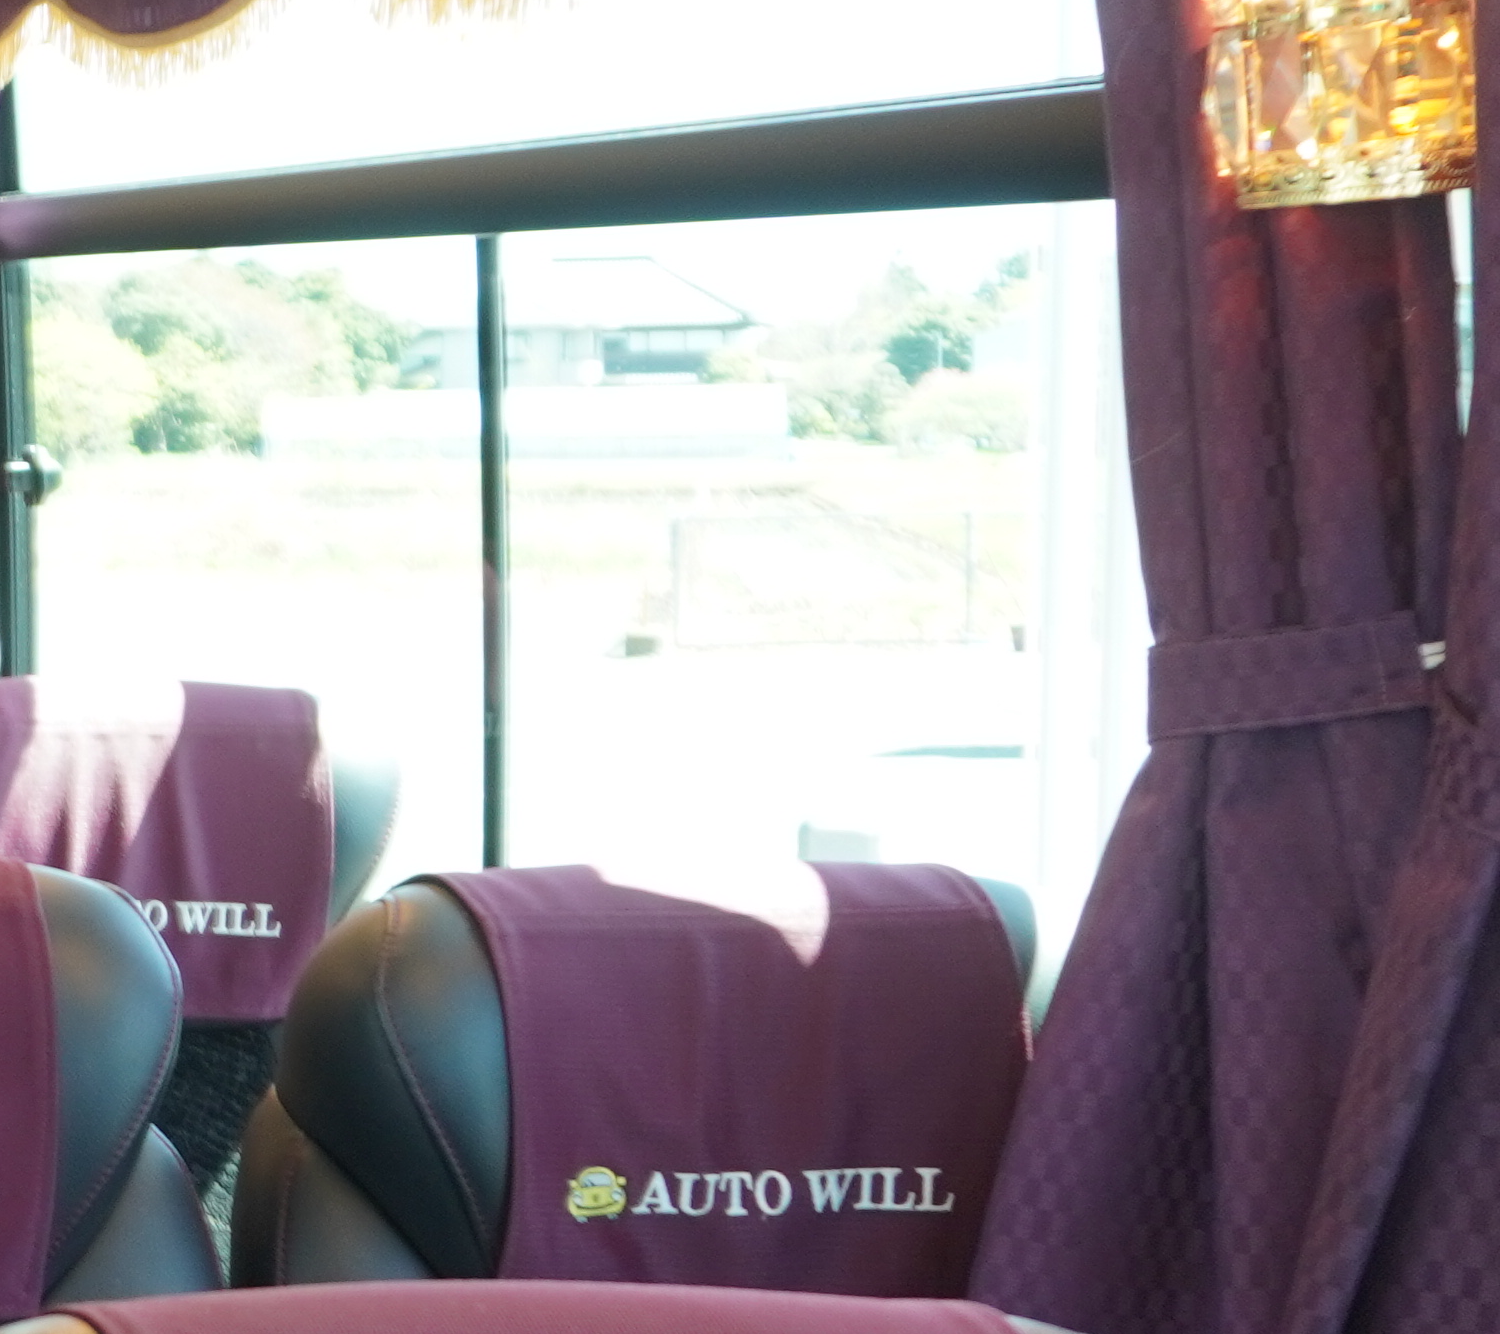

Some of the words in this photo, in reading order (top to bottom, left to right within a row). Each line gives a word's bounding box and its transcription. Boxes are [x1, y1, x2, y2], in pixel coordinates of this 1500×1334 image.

[174, 900, 282, 939] WILL
[631, 1169, 793, 1217] AUTO
[802, 1167, 955, 1213] WILL
